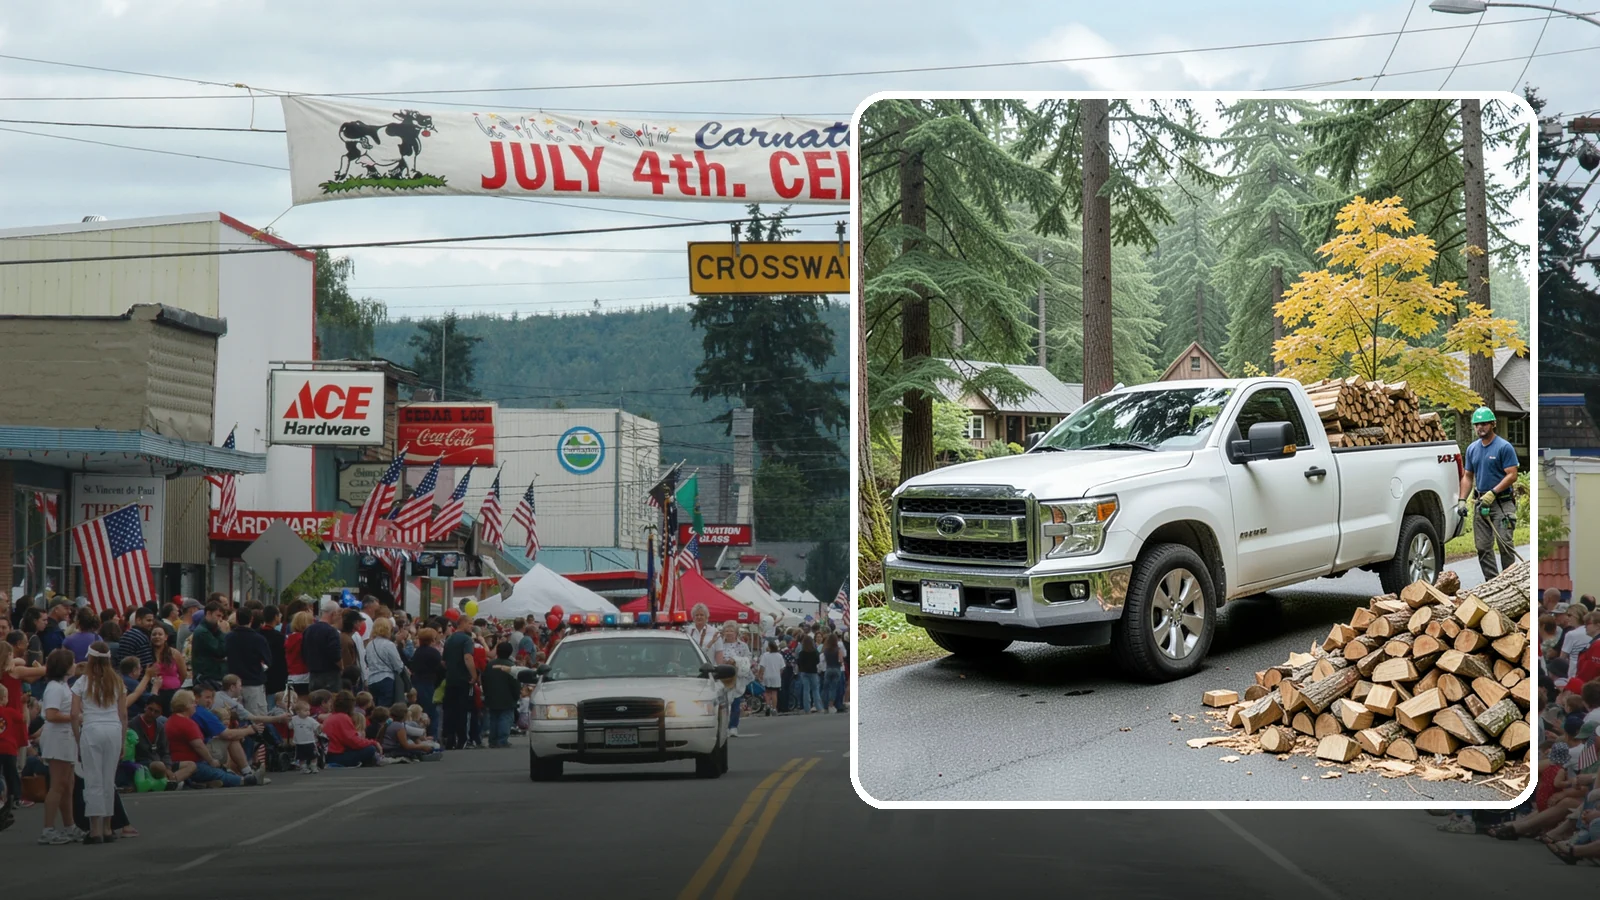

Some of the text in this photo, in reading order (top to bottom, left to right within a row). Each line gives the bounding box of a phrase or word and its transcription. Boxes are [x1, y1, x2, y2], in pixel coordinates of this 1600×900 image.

[695, 121, 850, 150] Carnat
[481, 141, 605, 192] JULY
[632, 150, 746, 198] 4th.
[696, 254, 850, 280] CROSSWA
[282, 379, 374, 420] ACE
[405, 408, 453, 422] CEDAR
[283, 420, 371, 437] Hardware
[416, 428, 477, 447] Coca-Cola
[82, 484, 155, 496] St. Vincent de Paul
[688, 526, 741, 535] CRNATION
[699, 535, 730, 543] GLASS
